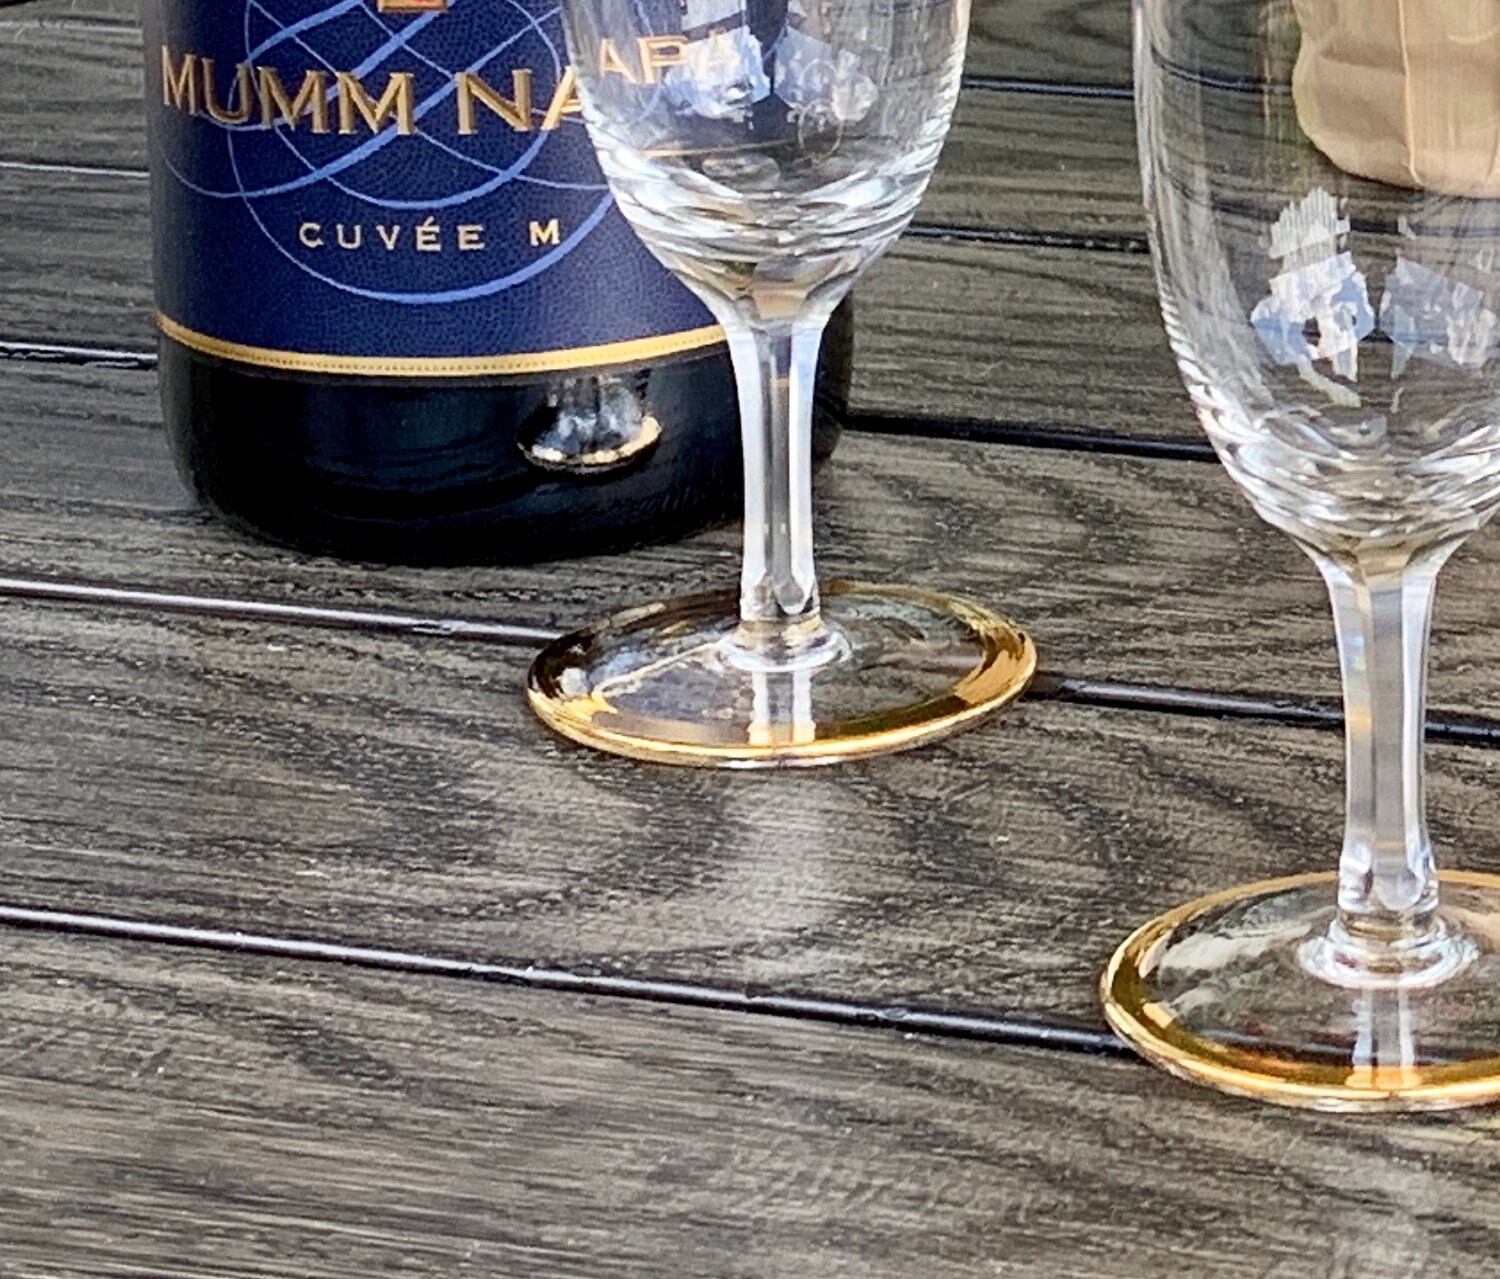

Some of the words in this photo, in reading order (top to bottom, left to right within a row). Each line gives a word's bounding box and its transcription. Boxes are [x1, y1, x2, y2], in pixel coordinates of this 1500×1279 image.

[161, 45, 415, 135] MUMM
[299, 216, 485, 252] CUVÉE
[528, 218, 561, 247] M
